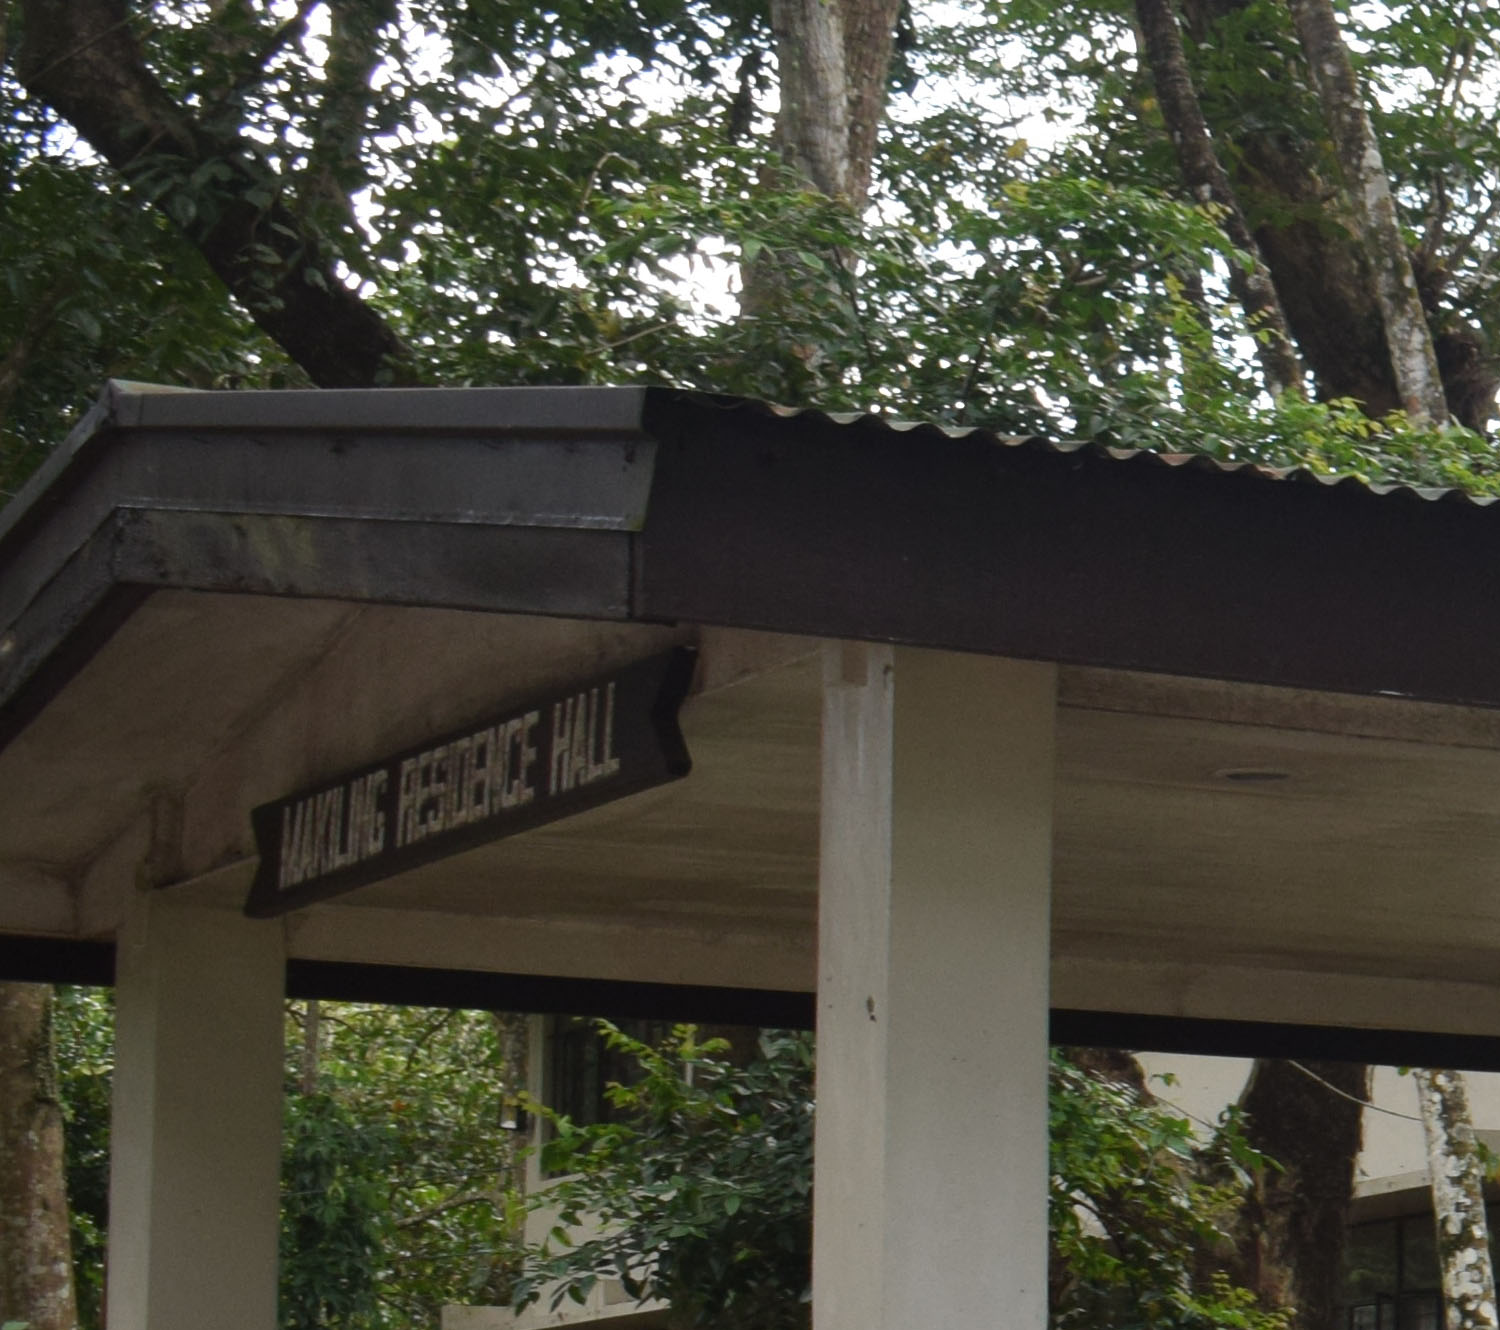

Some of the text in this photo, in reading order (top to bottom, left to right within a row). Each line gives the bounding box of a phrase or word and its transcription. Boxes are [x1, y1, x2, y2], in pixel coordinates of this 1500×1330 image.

[277, 681, 621, 891] MAKILING RESIDENCE HALL
